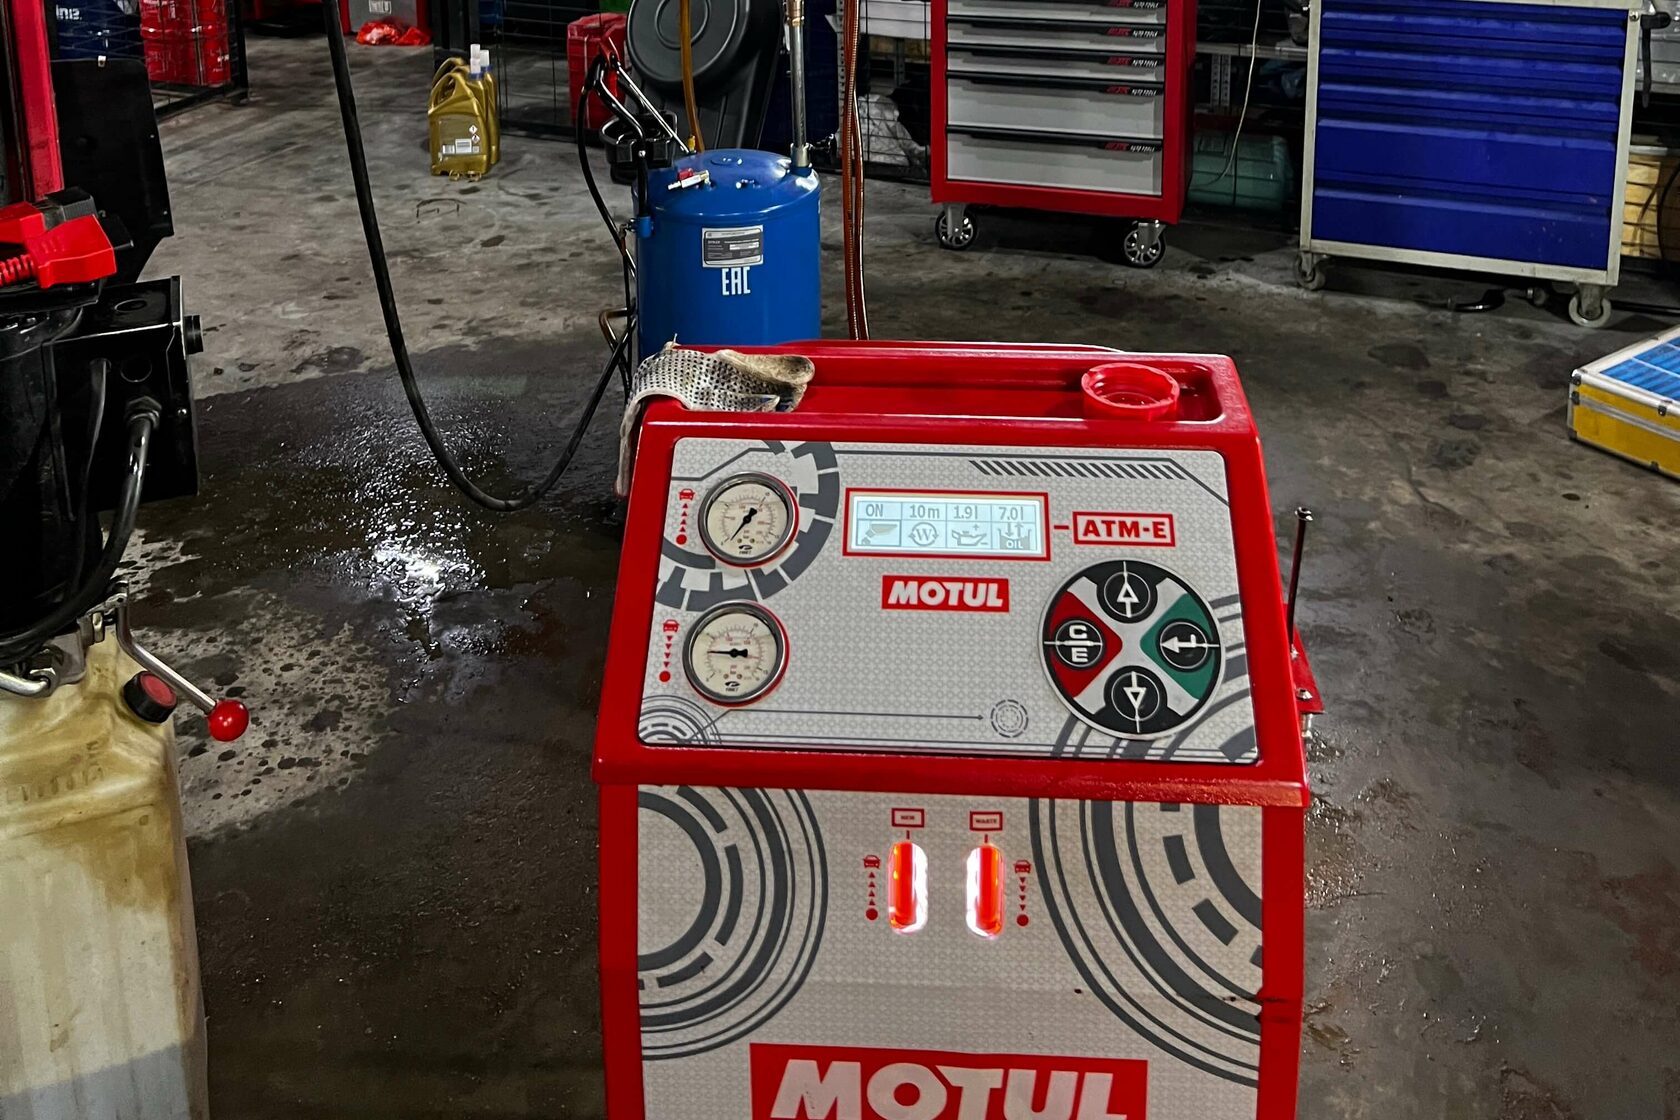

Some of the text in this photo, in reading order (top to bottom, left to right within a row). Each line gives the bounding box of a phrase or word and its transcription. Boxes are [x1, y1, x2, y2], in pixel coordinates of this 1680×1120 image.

[721, 266, 751, 296] EAC
[865, 504, 884, 518] ON
[1082, 519, 1168, 539] ATM-E
[1006, 541, 1023, 549] OIL
[887, 580, 1004, 608] MOTUL
[1068, 624, 1089, 639] C
[1071, 647, 1089, 663] E
[770, 1058, 1128, 1120] MOTUL
